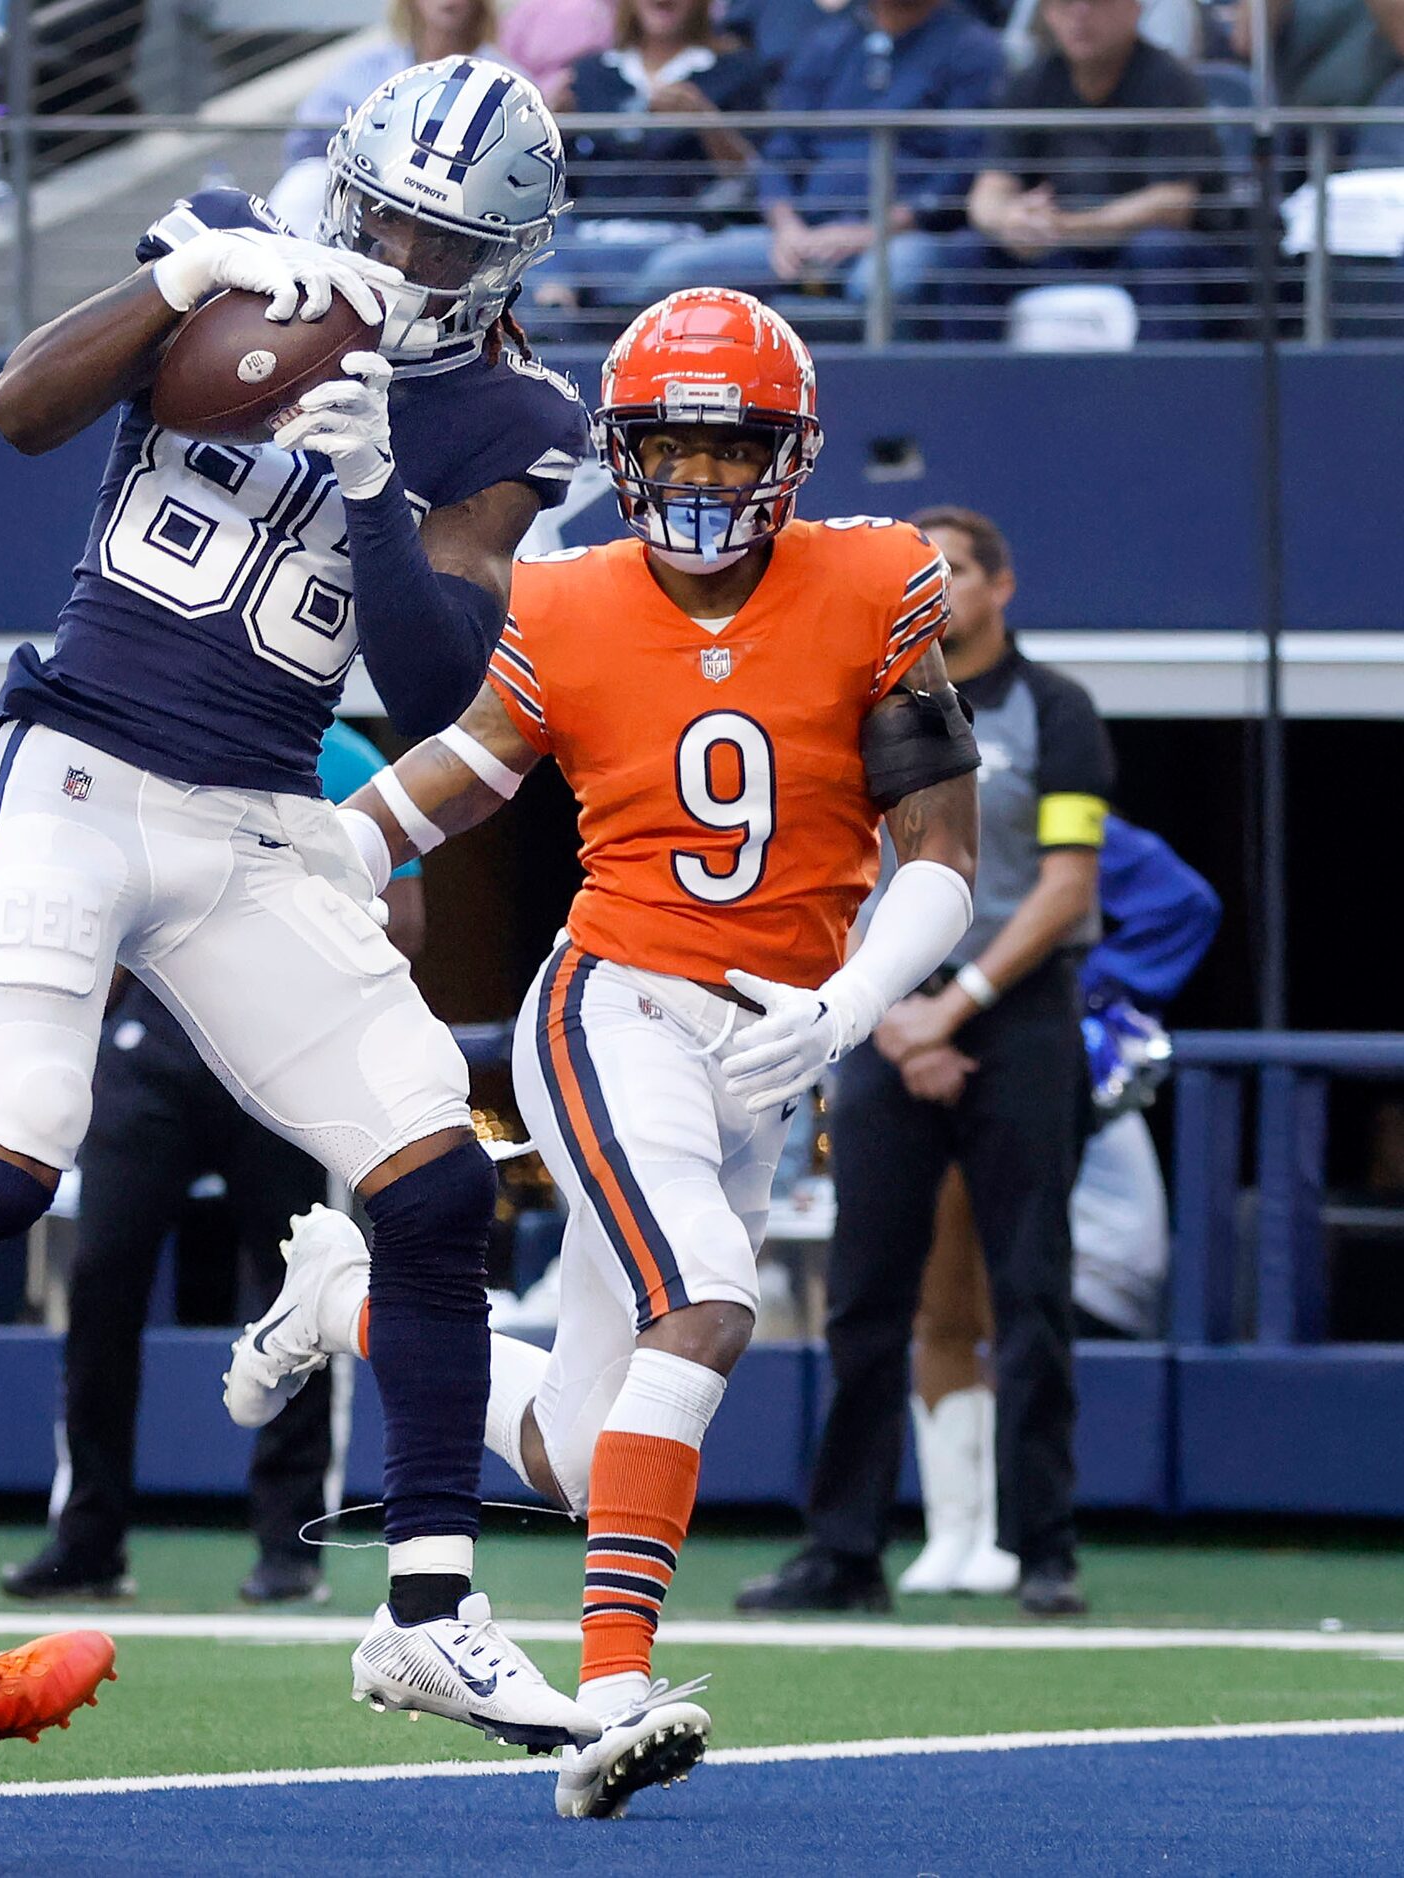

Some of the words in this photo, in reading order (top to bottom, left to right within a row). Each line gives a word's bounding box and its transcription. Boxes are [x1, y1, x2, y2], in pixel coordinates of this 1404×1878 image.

[404, 176, 448, 201] COWBOYS
[99, 428, 426, 687] 88
[670, 708, 776, 907] 9
